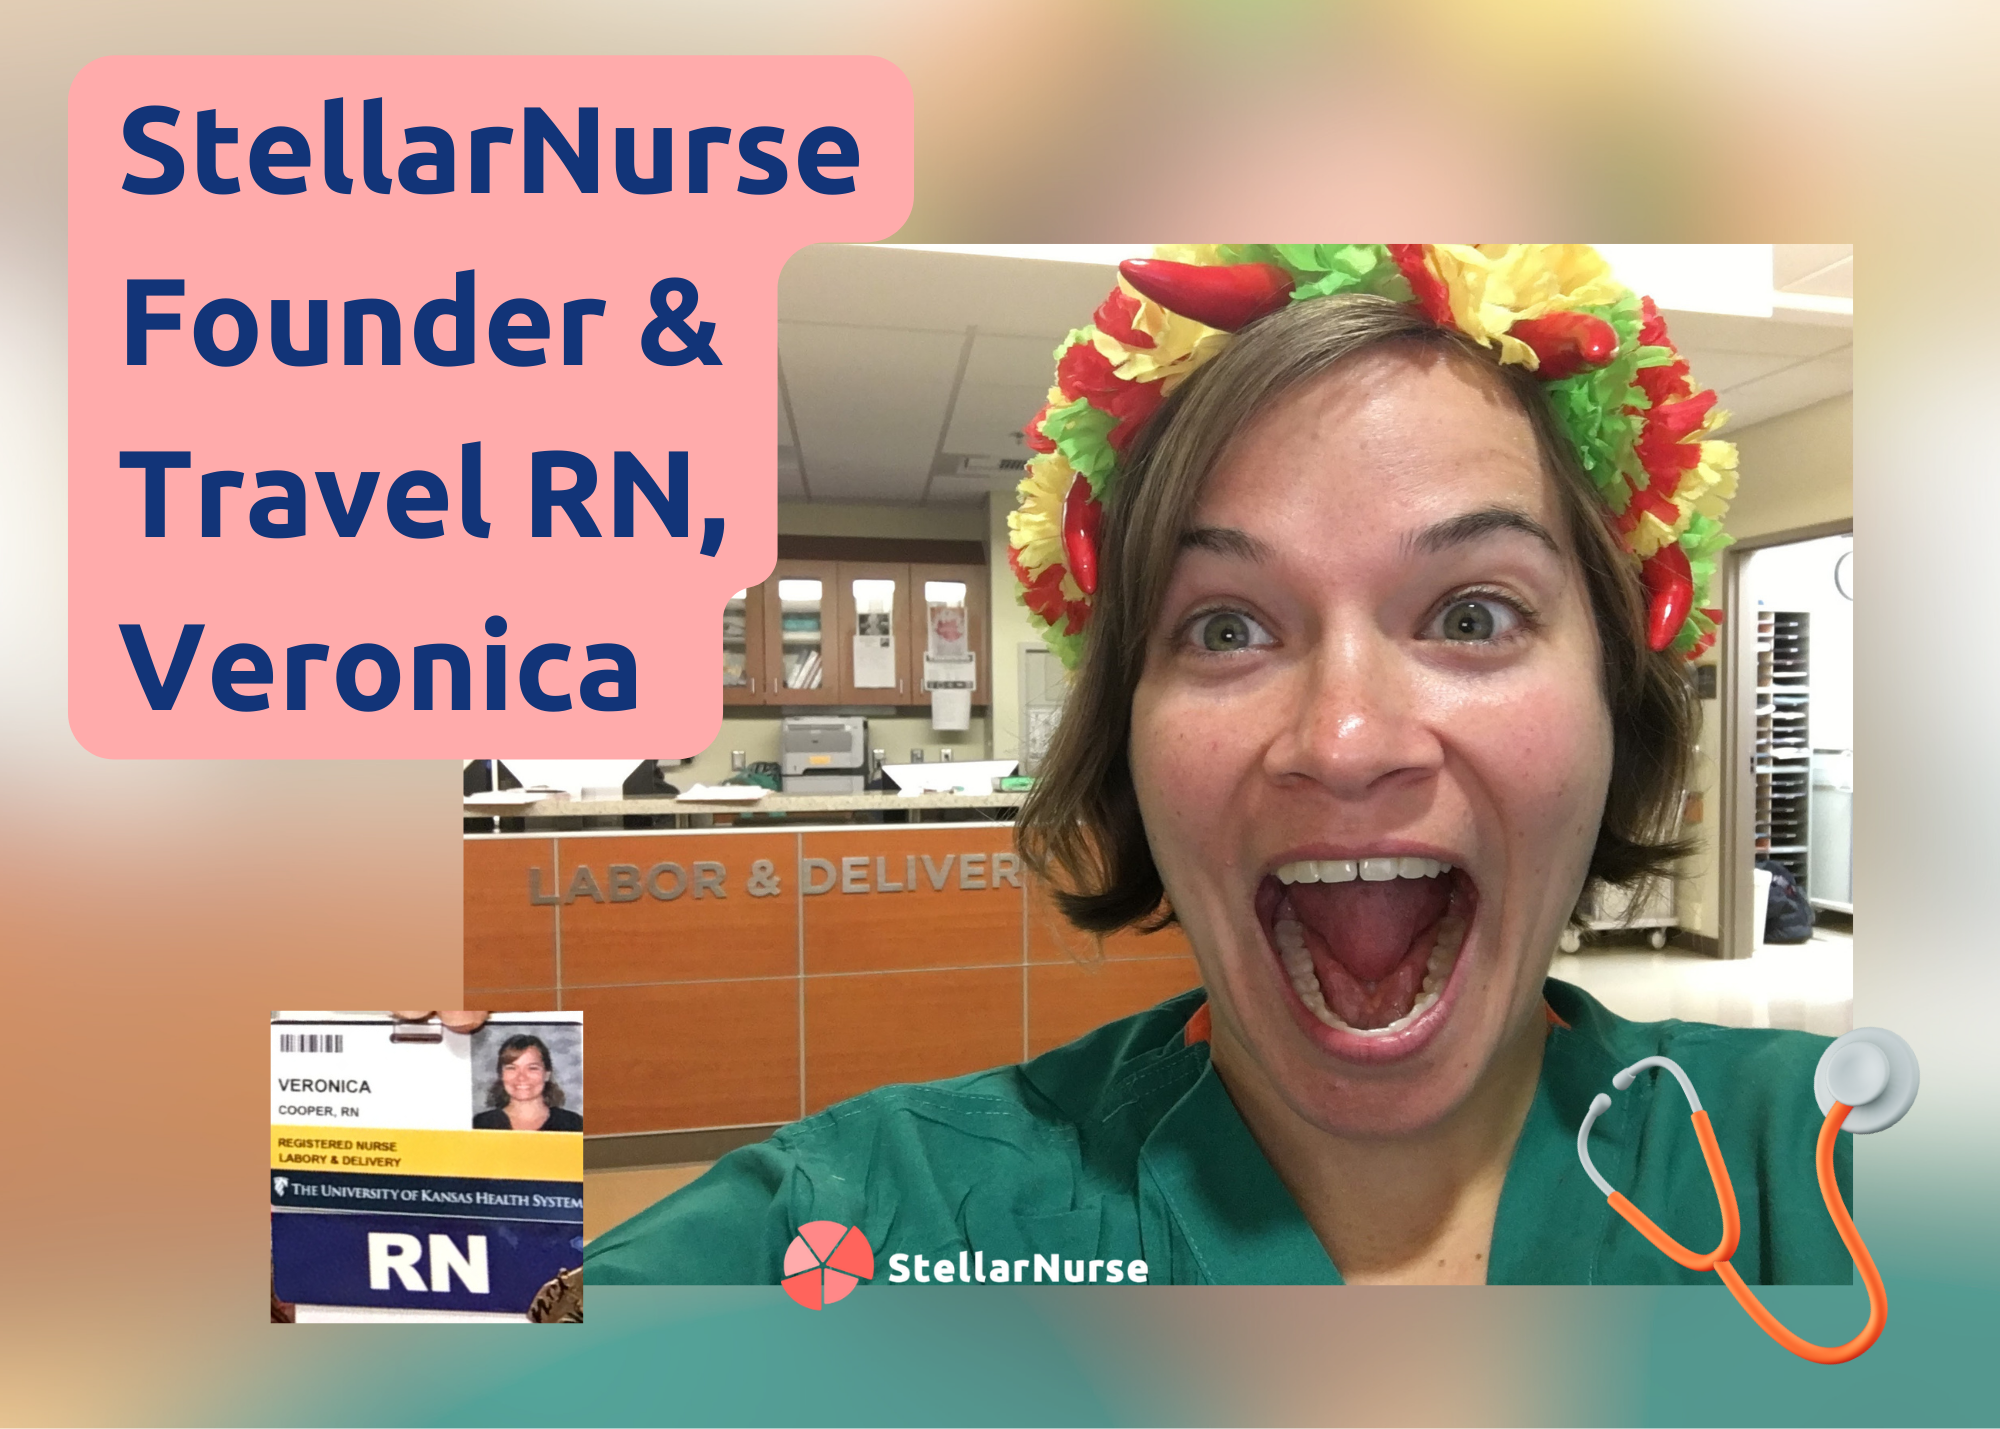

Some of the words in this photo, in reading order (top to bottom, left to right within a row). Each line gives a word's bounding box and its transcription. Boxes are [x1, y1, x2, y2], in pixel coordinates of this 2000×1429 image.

[529, 860, 728, 906] LABOR
[747, 858, 781, 898] &
[802, 852, 1024, 896] DELIVER
[278, 1078, 372, 1094] VERONICA
[278, 1105, 337, 1118] COOPER,
[341, 1107, 360, 1117] RN
[278, 1138, 353, 1150] REGISTERED
[356, 1141, 398, 1152] NURSE
[278, 1153, 327, 1164] LABORY
[330, 1155, 339, 1165] &
[342, 1156, 401, 1167] DELIVERY
[291, 1183, 318, 1196] THE
[321, 1184, 399, 1200] UNIVERSITY
[401, 1190, 418, 1200] OF
[421, 1190, 473, 1204] KANSAS
[476, 1192, 529, 1206] HEALTH
[532, 1195, 583, 1208] SYSTEM
[368, 1232, 489, 1294] RN
